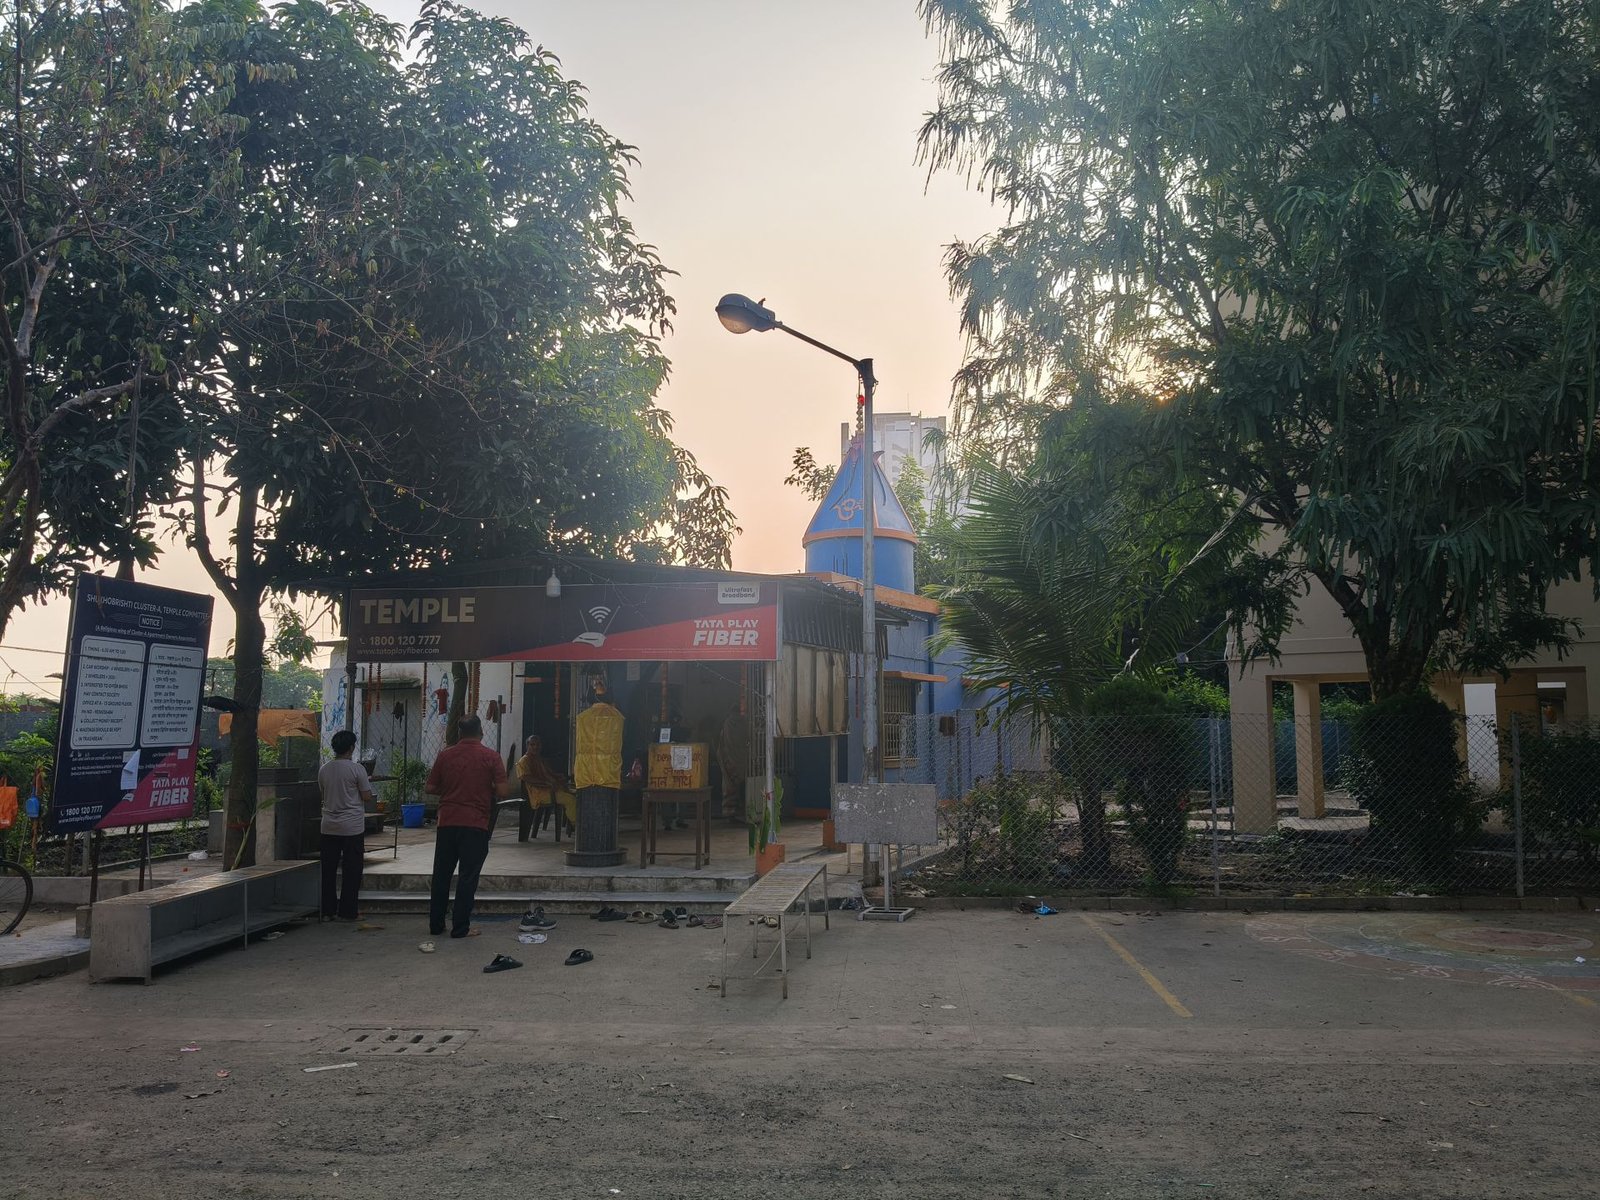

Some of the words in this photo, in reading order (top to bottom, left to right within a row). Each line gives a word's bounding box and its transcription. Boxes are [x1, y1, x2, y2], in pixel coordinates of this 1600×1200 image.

[163, 606, 182, 616] TEMPLE
[360, 597, 476, 624] TEMPLE
[142, 618, 160, 627] NOTICE
[694, 620, 724, 628] TATA
[728, 620, 758, 628] PLAY
[370, 635, 394, 646] 1800
[398, 635, 415, 645] 120
[418, 635, 441, 645] 7777
[692, 631, 758, 646] FIBER
[152, 778, 170, 788] TATA
[172, 776, 190, 786] PLAY
[149, 787, 189, 807] FIBER
[66, 808, 80, 816] 1800
[91, 805, 103, 813] 7777
